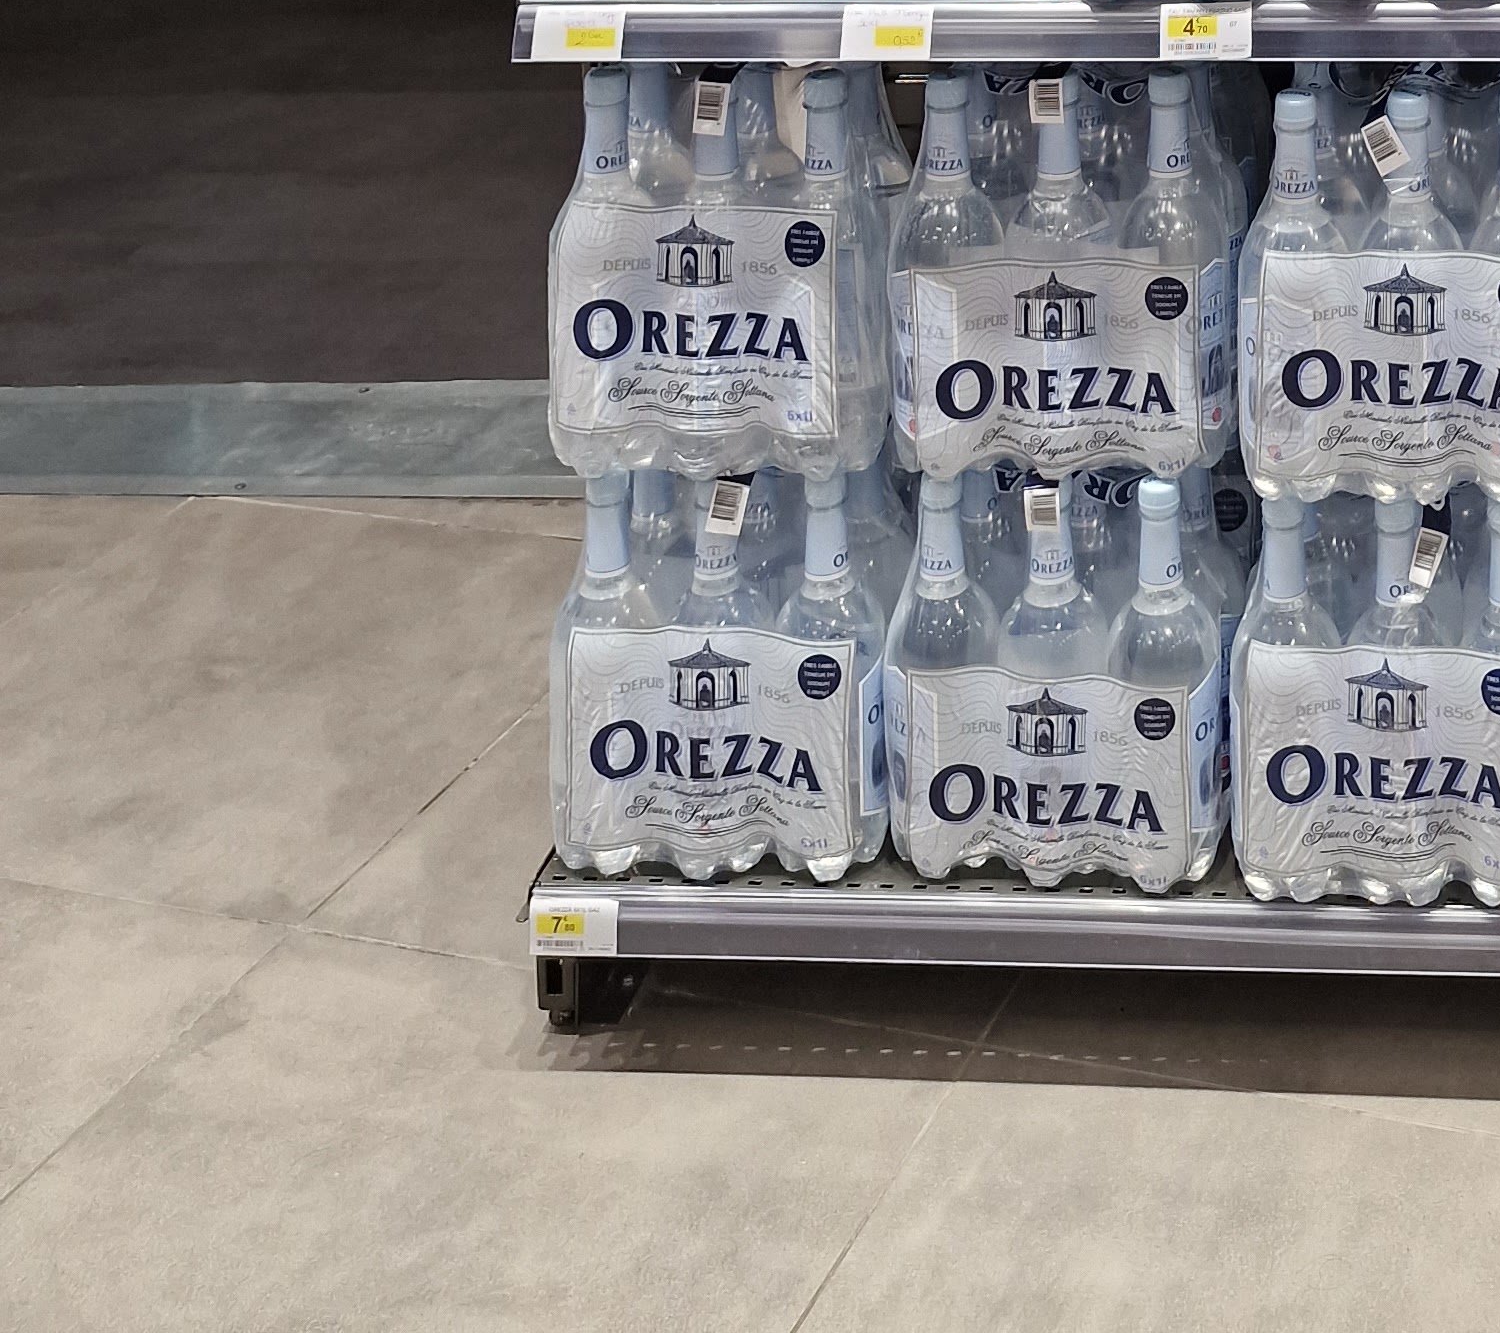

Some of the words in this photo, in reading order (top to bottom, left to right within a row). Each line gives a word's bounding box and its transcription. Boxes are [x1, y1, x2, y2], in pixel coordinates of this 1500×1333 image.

[573, 297, 810, 363] OREZZA
[1312, 304, 1359, 322] DEPUIS
[1453, 307, 1491, 324] 1856
[935, 358, 1178, 421] OREZZA
[1434, 705, 1474, 721] 1856
[589, 718, 824, 794] OREZZA
[928, 763, 1167, 834] OREZZA
